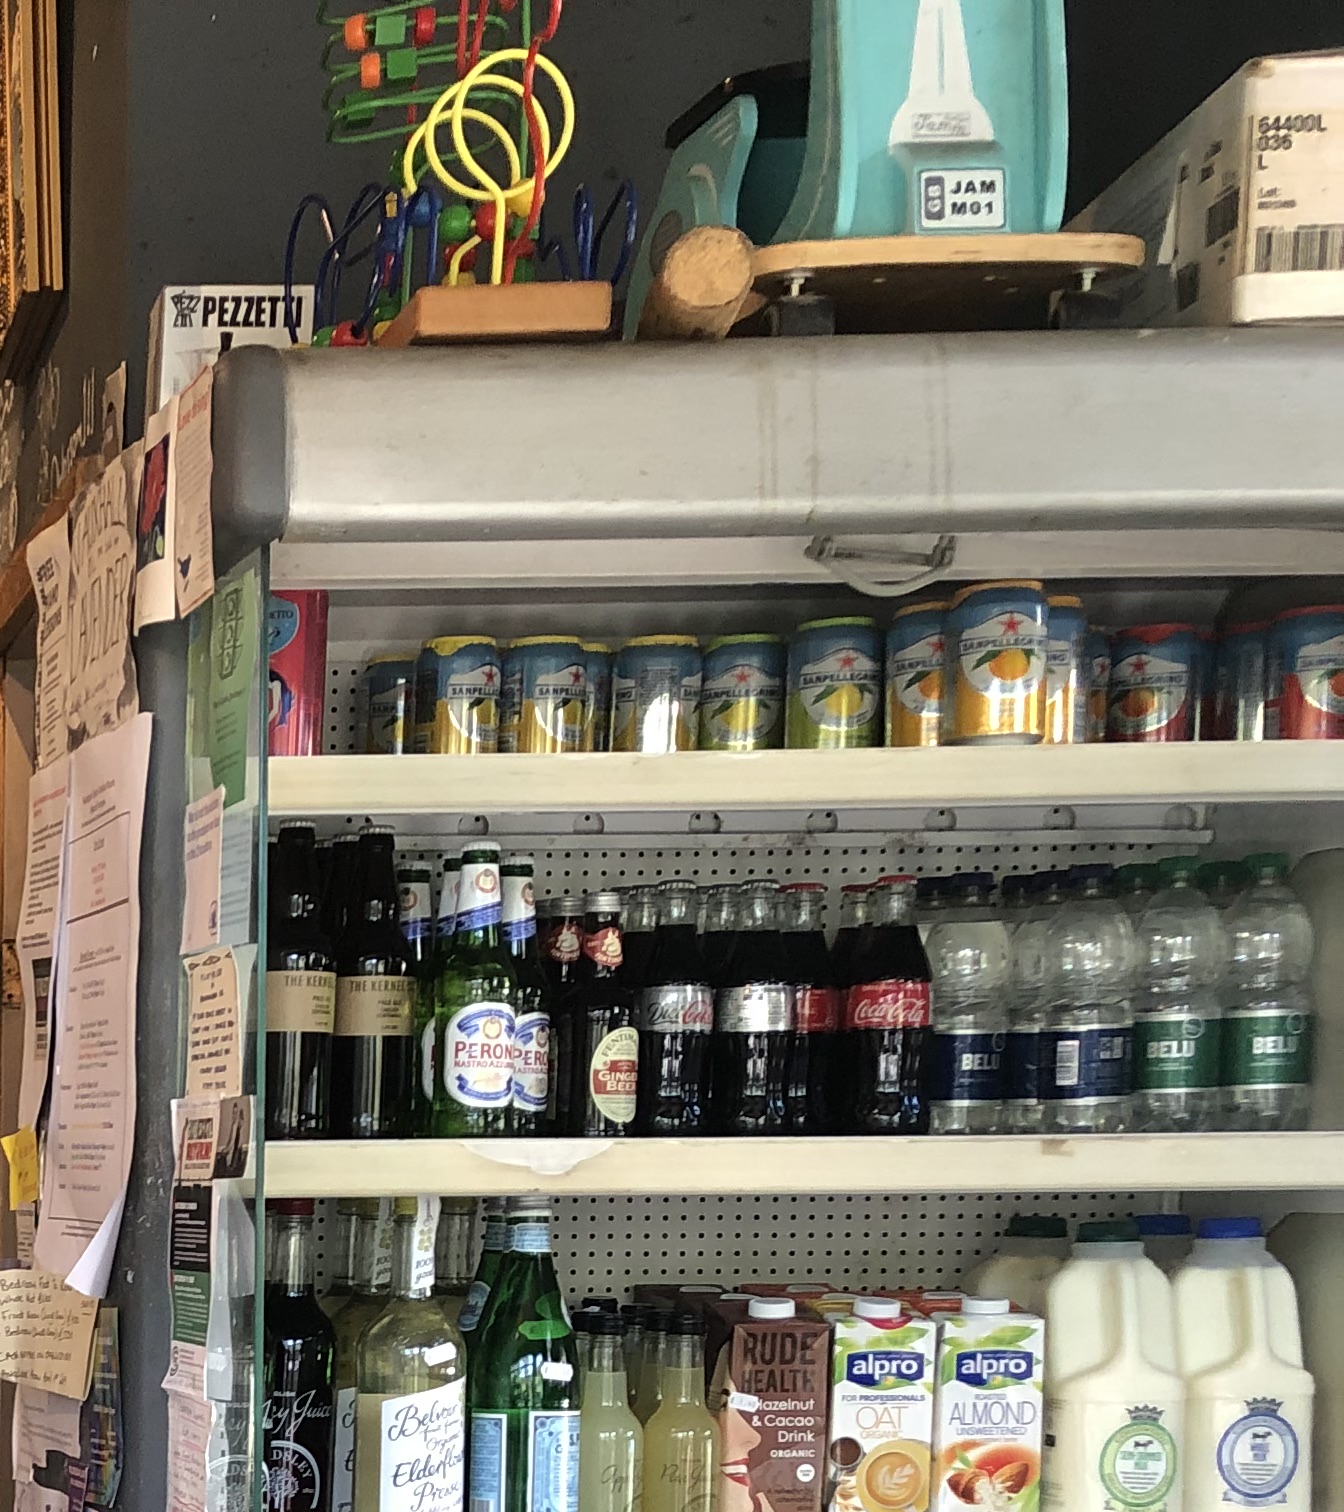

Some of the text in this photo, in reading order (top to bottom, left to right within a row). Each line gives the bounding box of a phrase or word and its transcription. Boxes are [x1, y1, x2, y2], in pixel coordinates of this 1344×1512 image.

[950, 180, 997, 195] JAM
[285, 975, 302, 987] THE
[350, 980, 367, 993] THE
[1146, 1039, 1196, 1059] BELU
[598, 1071, 639, 1082] GINGE
[742, 1332, 818, 1366] RUDE
[852, 1354, 919, 1380] alpro
[961, 1353, 1028, 1379] alpro
[741, 1368, 817, 1393] HEALTH
[751, 1415, 815, 1427] & Cacao
[856, 1406, 909, 1430] OAT
[949, 1401, 1037, 1426] ALMOND
[777, 1429, 815, 1442] Drink
[956, 1427, 1027, 1436] UNSWEETENED
[770, 1449, 816, 1458] ORGANIC
